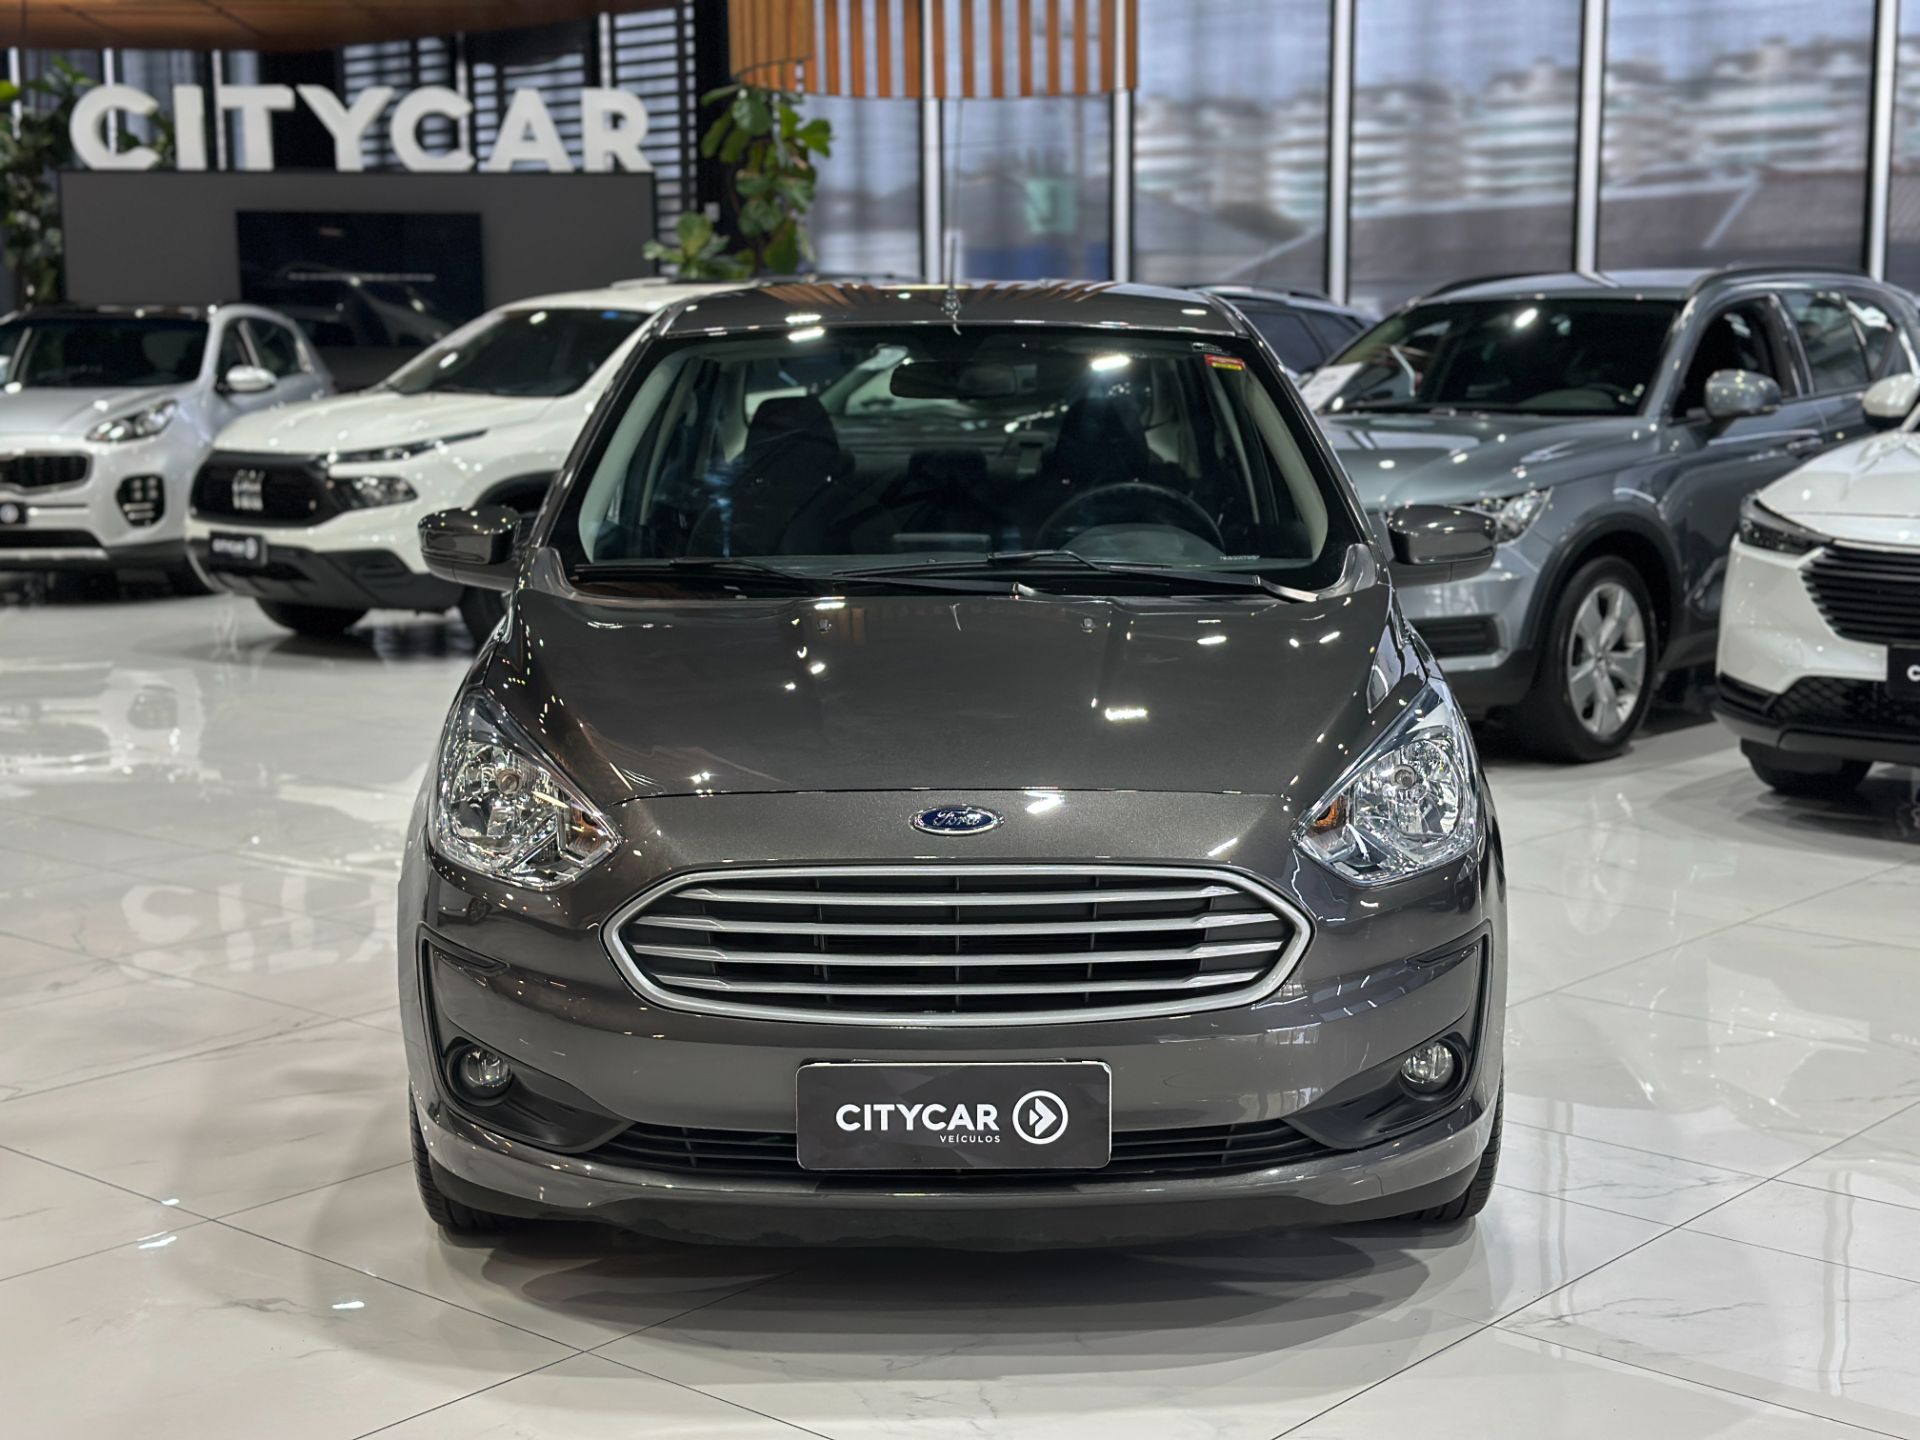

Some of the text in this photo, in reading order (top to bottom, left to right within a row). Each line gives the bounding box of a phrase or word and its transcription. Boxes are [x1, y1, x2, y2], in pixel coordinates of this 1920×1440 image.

[69, 84, 655, 173] CITYCAR
[932, 811, 982, 827] Ford
[835, 1103, 1000, 1132] CITYCAR
[939, 1134, 1001, 1144] VEÍCULOS
